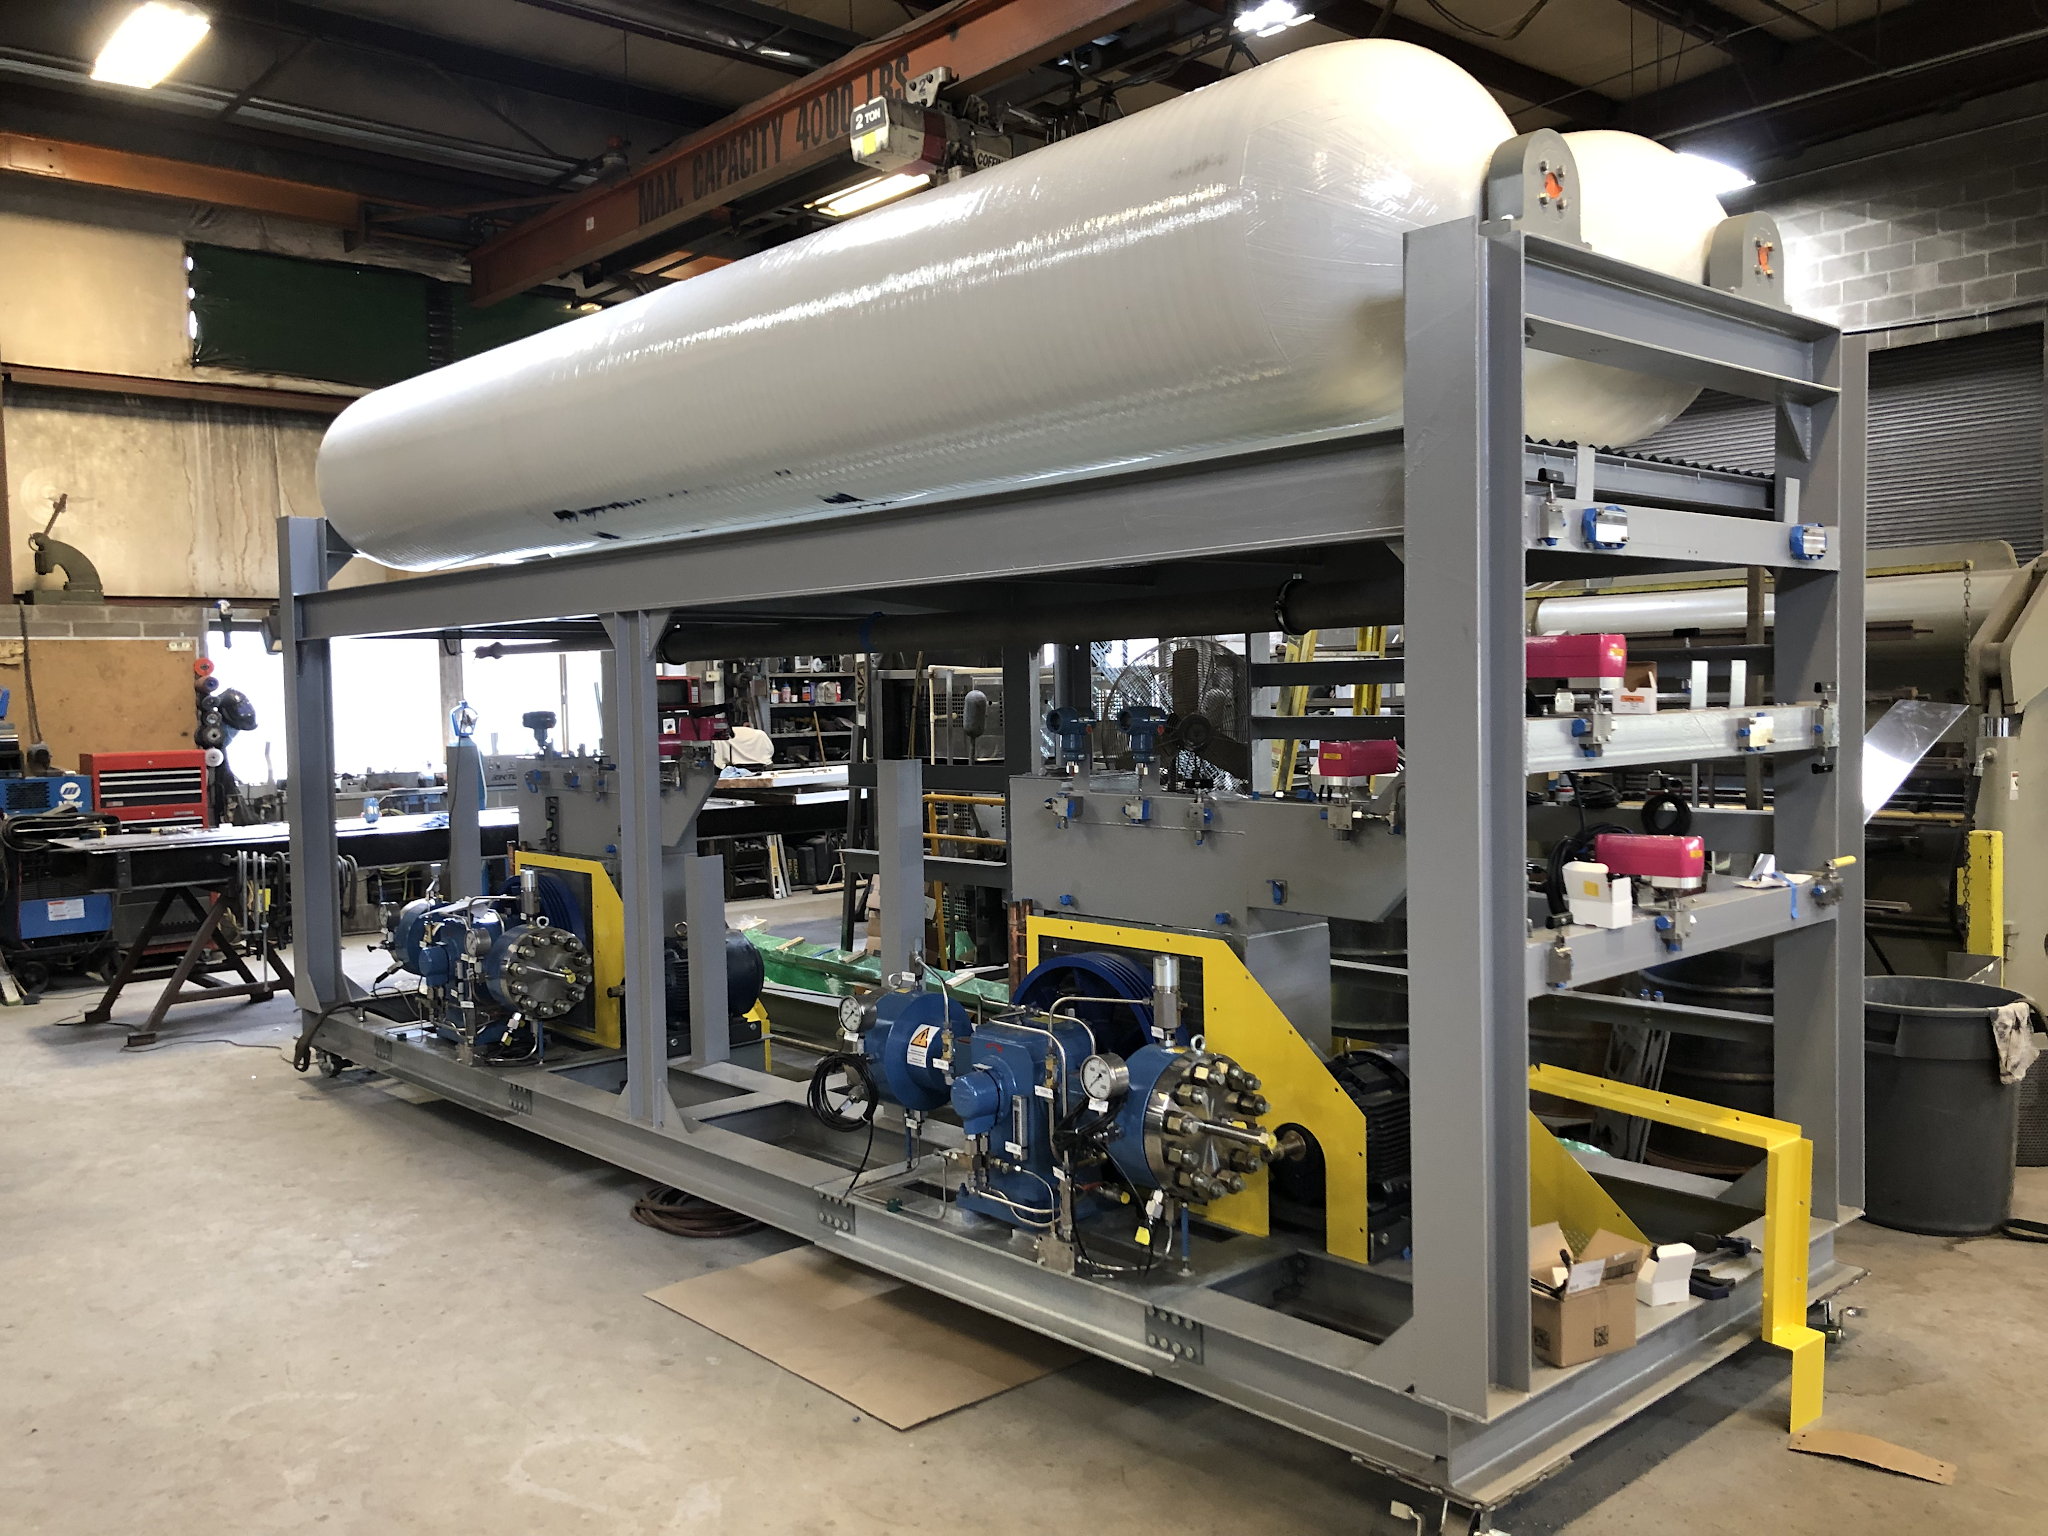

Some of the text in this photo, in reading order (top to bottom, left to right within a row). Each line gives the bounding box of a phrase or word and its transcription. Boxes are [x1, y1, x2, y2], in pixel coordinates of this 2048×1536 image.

[638, 53, 909, 225] MAX. CAPACITY 4000 LBS
[855, 107, 881, 130] 2 TON
